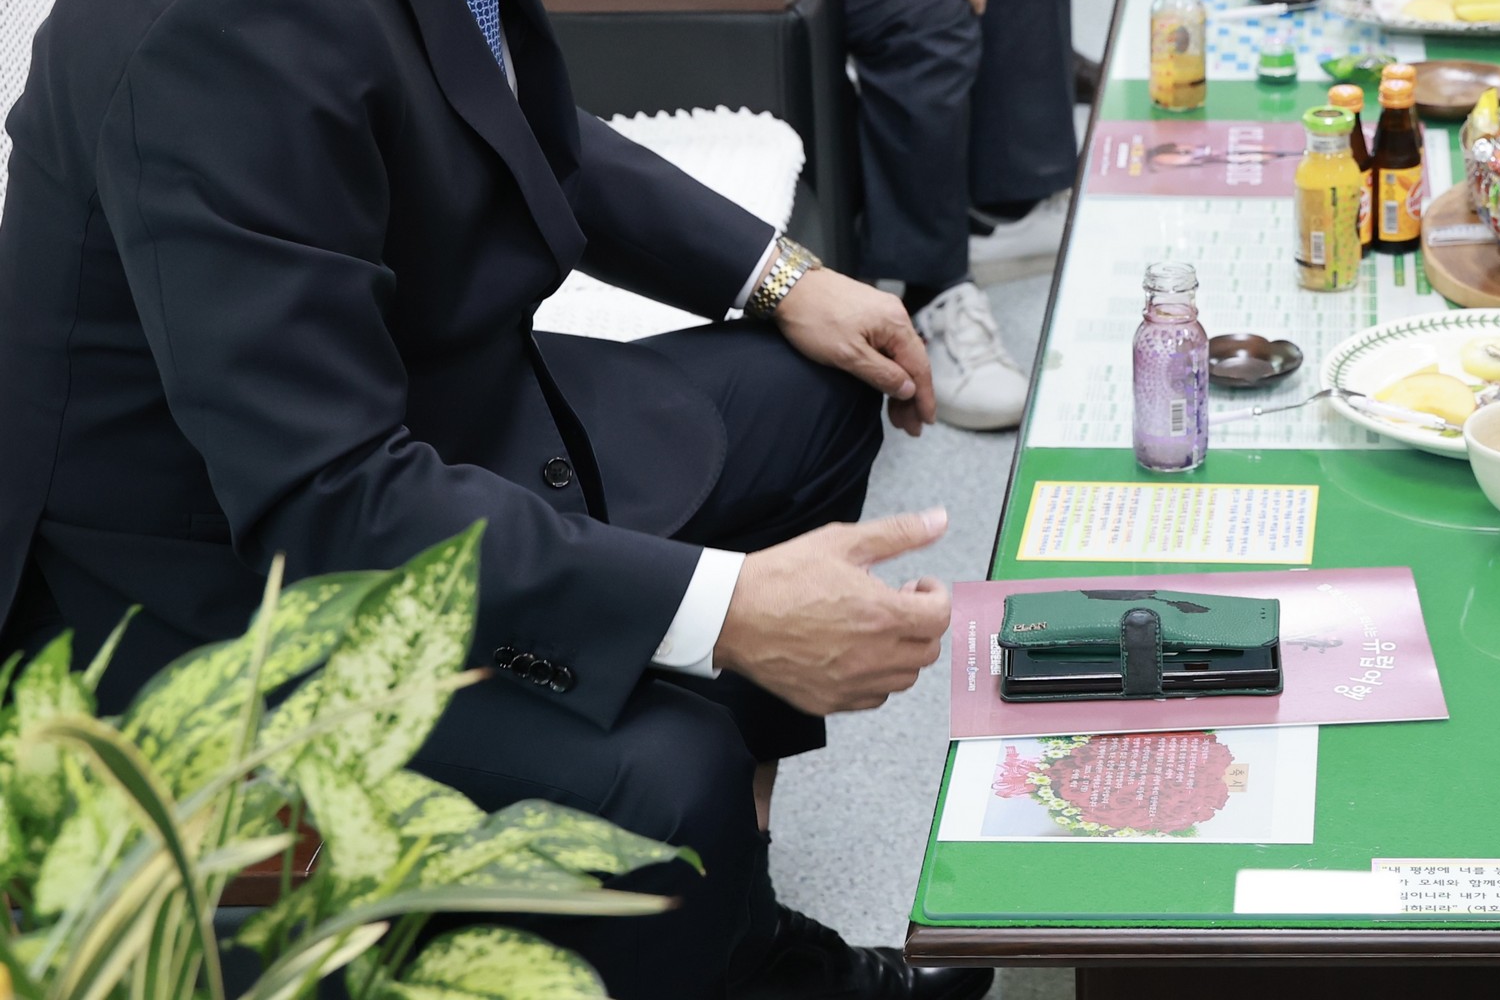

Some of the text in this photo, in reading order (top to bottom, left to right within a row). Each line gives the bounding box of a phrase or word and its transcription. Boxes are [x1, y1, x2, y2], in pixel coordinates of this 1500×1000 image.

[1333, 638, 1397, 701] 유럽여행
[1410, 866, 1450, 875] 평생에
[1459, 866, 1486, 875] 너를
[1418, 879, 1459, 887] 모세와
[1460, 892, 1487, 900] 내가
